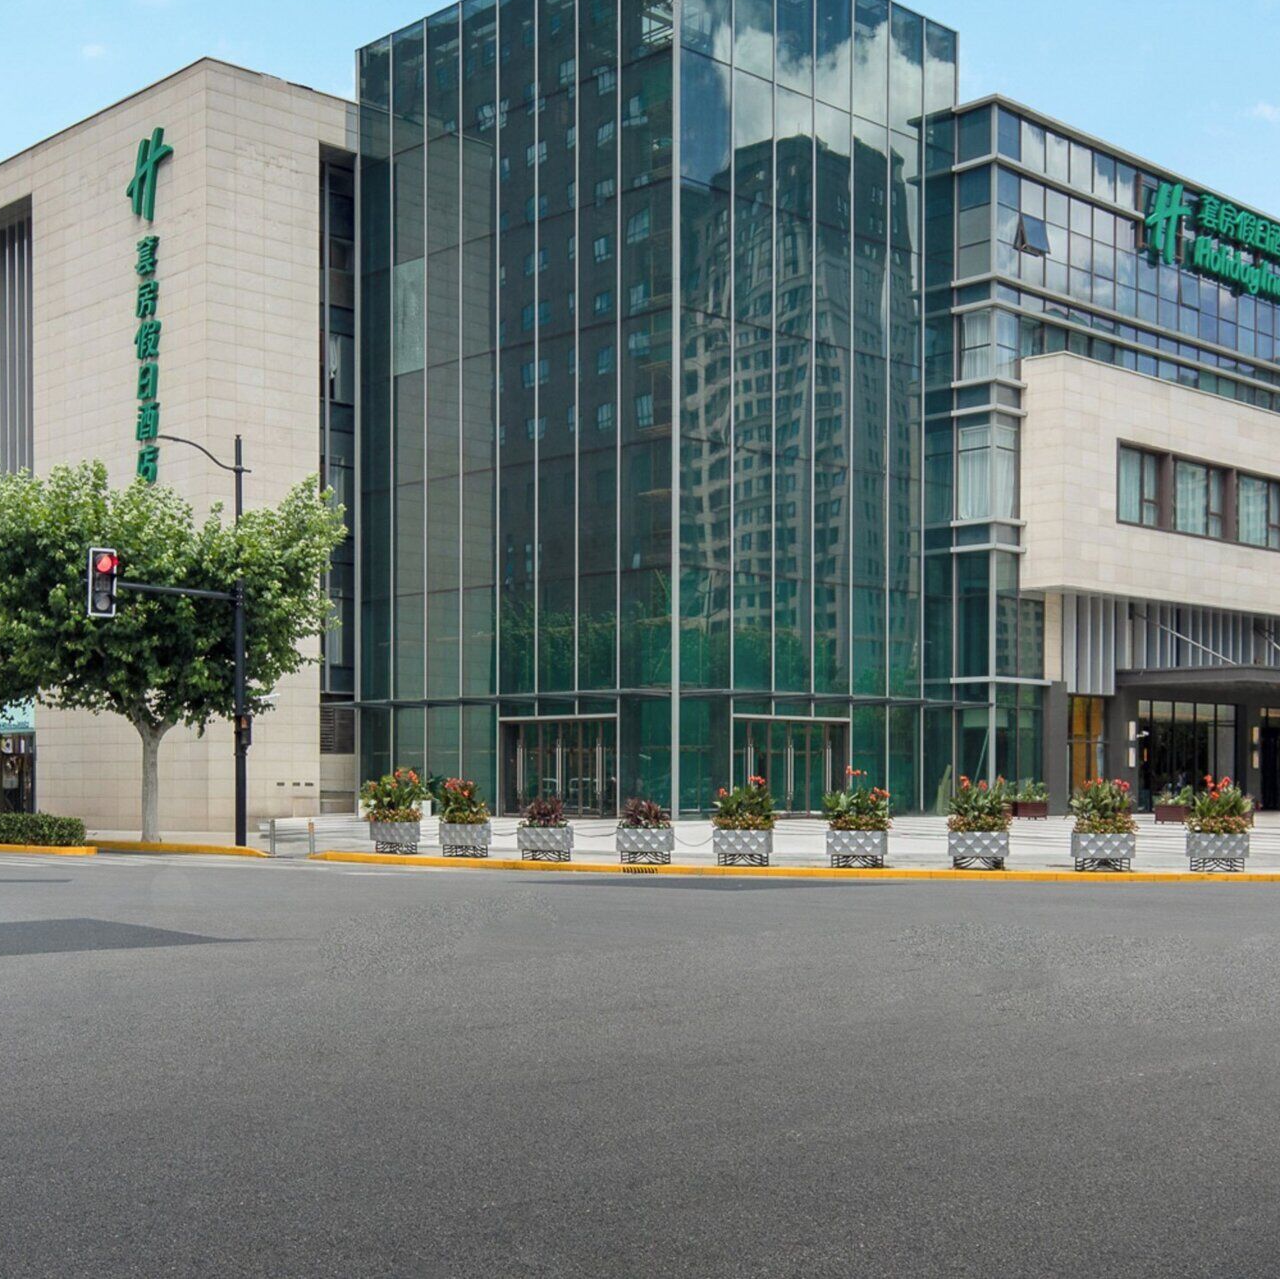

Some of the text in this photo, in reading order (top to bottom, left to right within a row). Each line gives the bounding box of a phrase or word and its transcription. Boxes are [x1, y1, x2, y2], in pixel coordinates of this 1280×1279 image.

[1193, 235, 1261, 294] Holiday
[134, 235, 161, 485] 套房假日酒店
